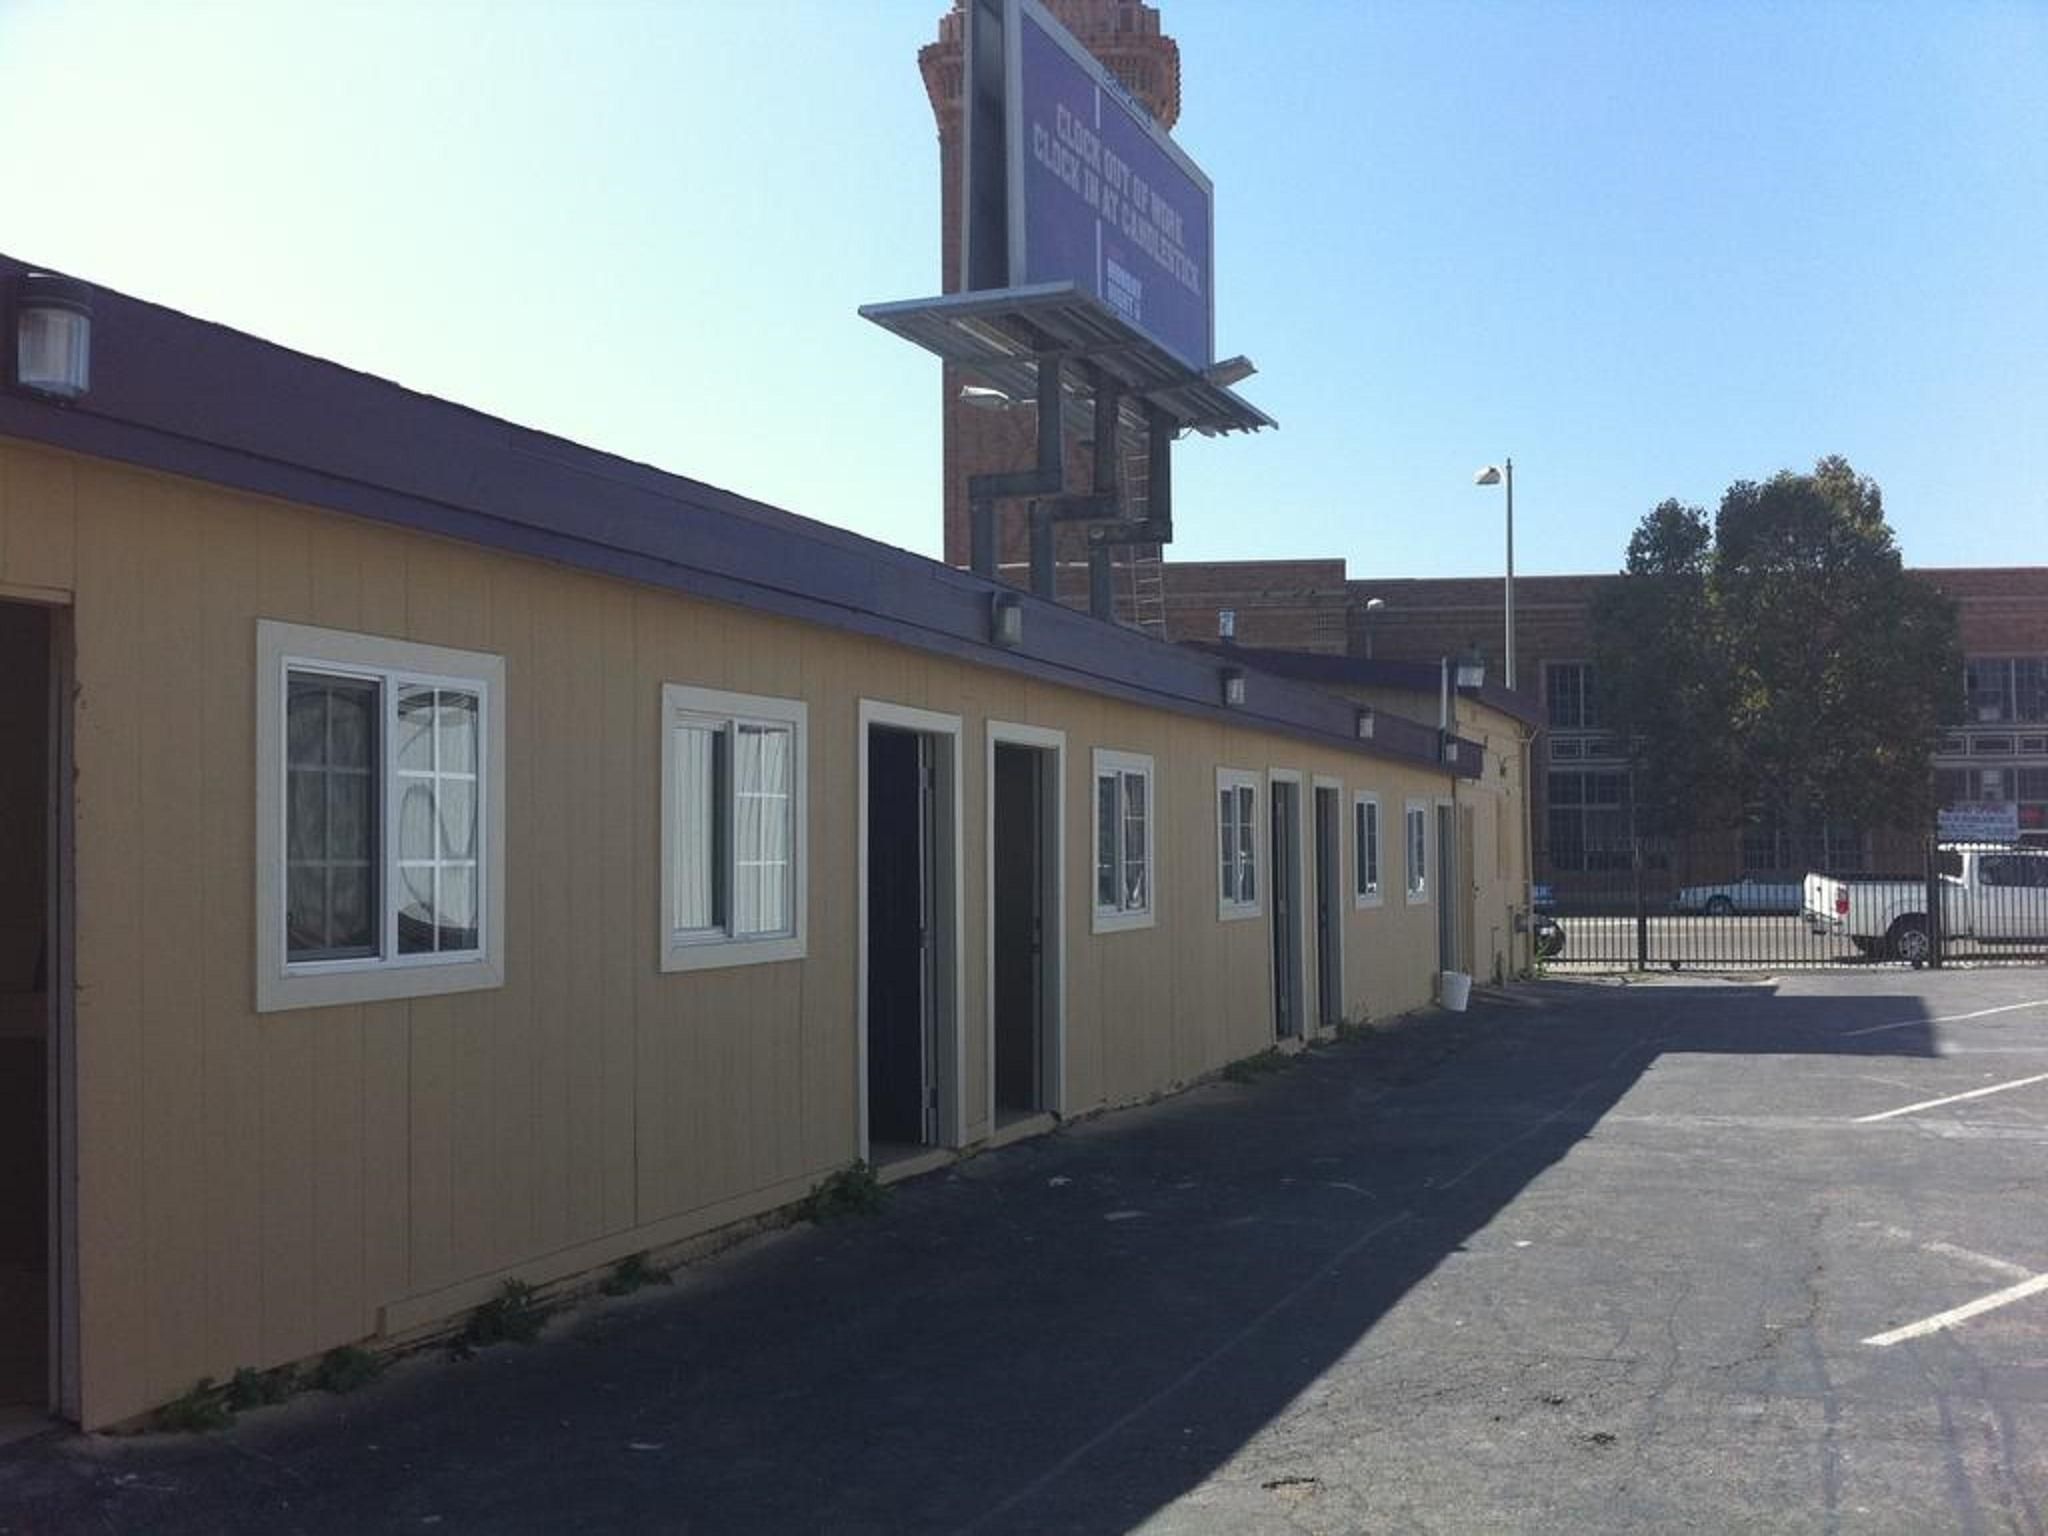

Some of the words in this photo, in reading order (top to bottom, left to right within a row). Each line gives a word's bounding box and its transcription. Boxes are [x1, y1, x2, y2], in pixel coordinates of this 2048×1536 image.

[1033, 122, 1081, 193] CLOCK
[1084, 167, 1100, 208] IN
[1102, 185, 1118, 225] AT
[1121, 201, 1201, 296] CANDLESTICK
[1056, 103, 1100, 174] CLOCK
[1104, 149, 1130, 196] OUT
[1133, 174, 1149, 213] OF
